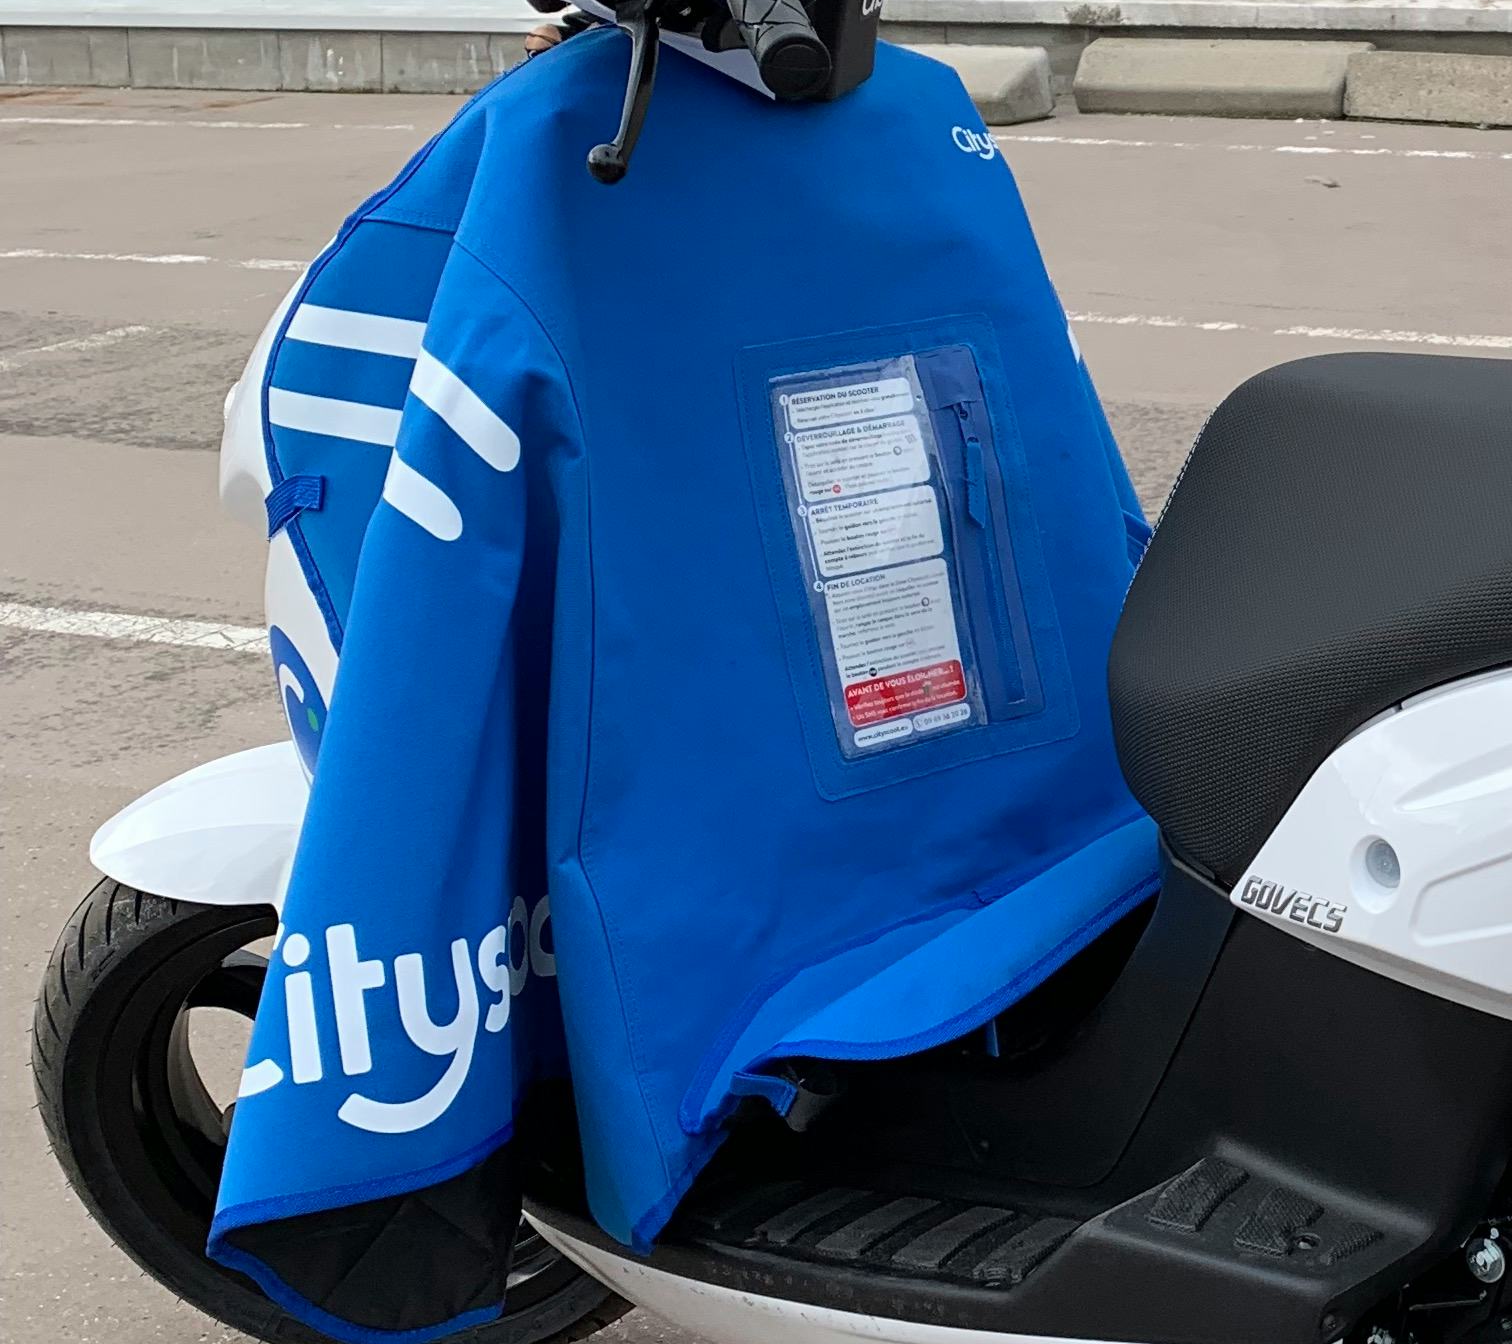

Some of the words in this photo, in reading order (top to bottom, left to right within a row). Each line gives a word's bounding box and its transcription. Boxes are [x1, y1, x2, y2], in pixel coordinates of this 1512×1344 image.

[848, 386, 879, 397] SCOOTER
[834, 498, 879, 511] TEMPORAIRE
[827, 581, 840, 591] FIN
[841, 580, 851, 589] DE
[851, 574, 886, 587] LOCATION
[848, 684, 873, 698] AVANT
[873, 682, 885, 692] DE
[885, 676, 906, 688] VOUS
[1241, 875, 1348, 933] GOVECS
